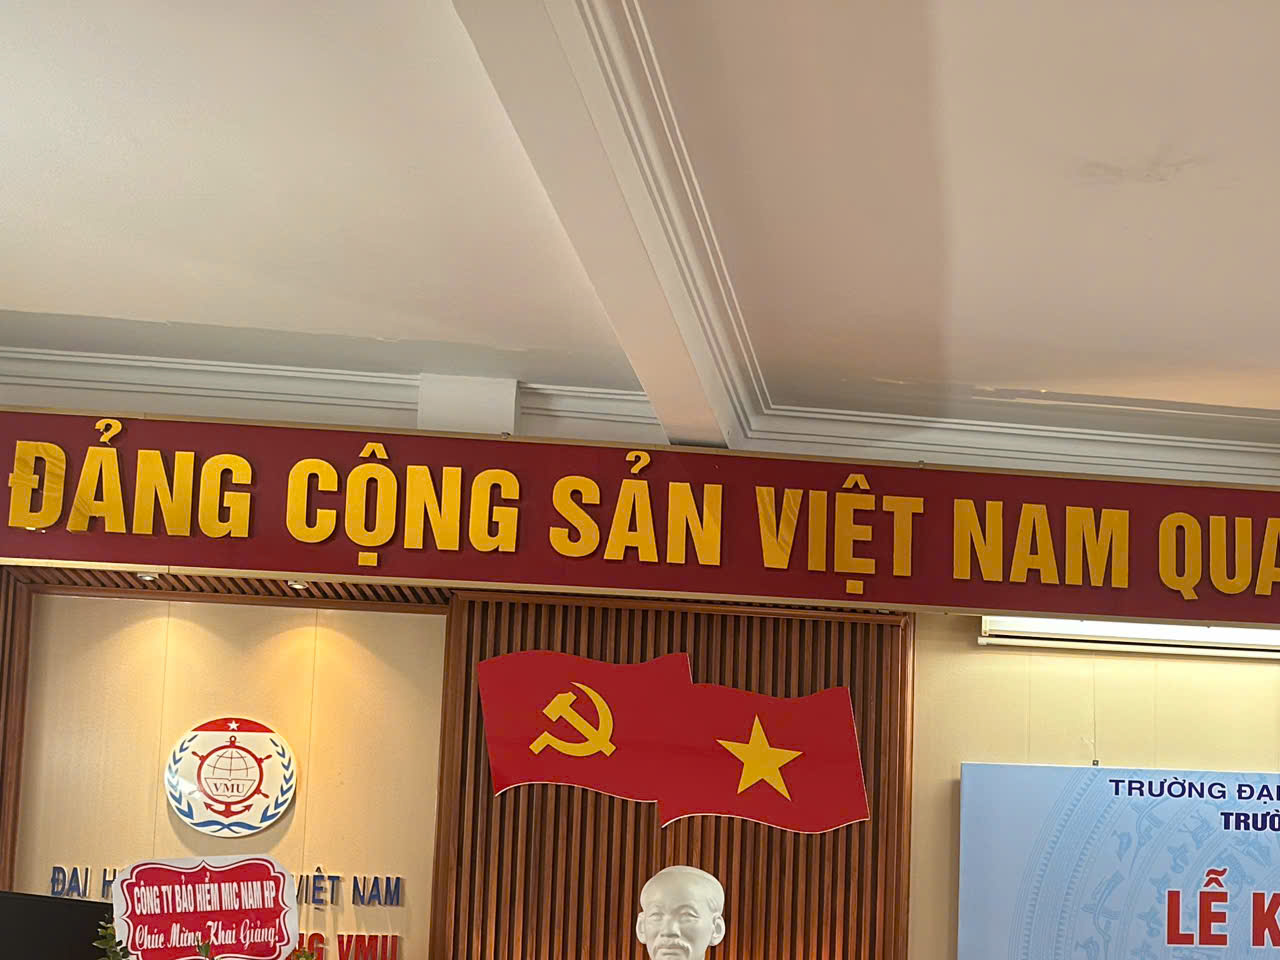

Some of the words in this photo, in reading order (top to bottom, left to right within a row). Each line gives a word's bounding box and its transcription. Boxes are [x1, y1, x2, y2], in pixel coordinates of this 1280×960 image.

[8, 418, 253, 538] ĐẢNG
[286, 442, 520, 567] CỘNG
[549, 450, 722, 566] SẢN
[755, 473, 924, 595] VIỆT
[953, 498, 1130, 588] NAM
[213, 783, 245, 793] VMU
[1109, 777, 1227, 800] TRƯỜNG
[1237, 783, 1280, 805] ĐẠI
[133, 880, 161, 916] CÔNG
[161, 885, 173, 914] TY
[174, 875, 194, 913] BẢO
[195, 872, 219, 912] HIỂM
[220, 881, 239, 910] MIC
[240, 880, 262, 910] NAM
[263, 880, 276, 908] HP
[352, 875, 401, 905] NAM
[1166, 868, 1228, 946] LỄ
[135, 924, 166, 950] Chúc
[206, 920, 237, 946] Khai
[240, 918, 280, 950] Giảng!
